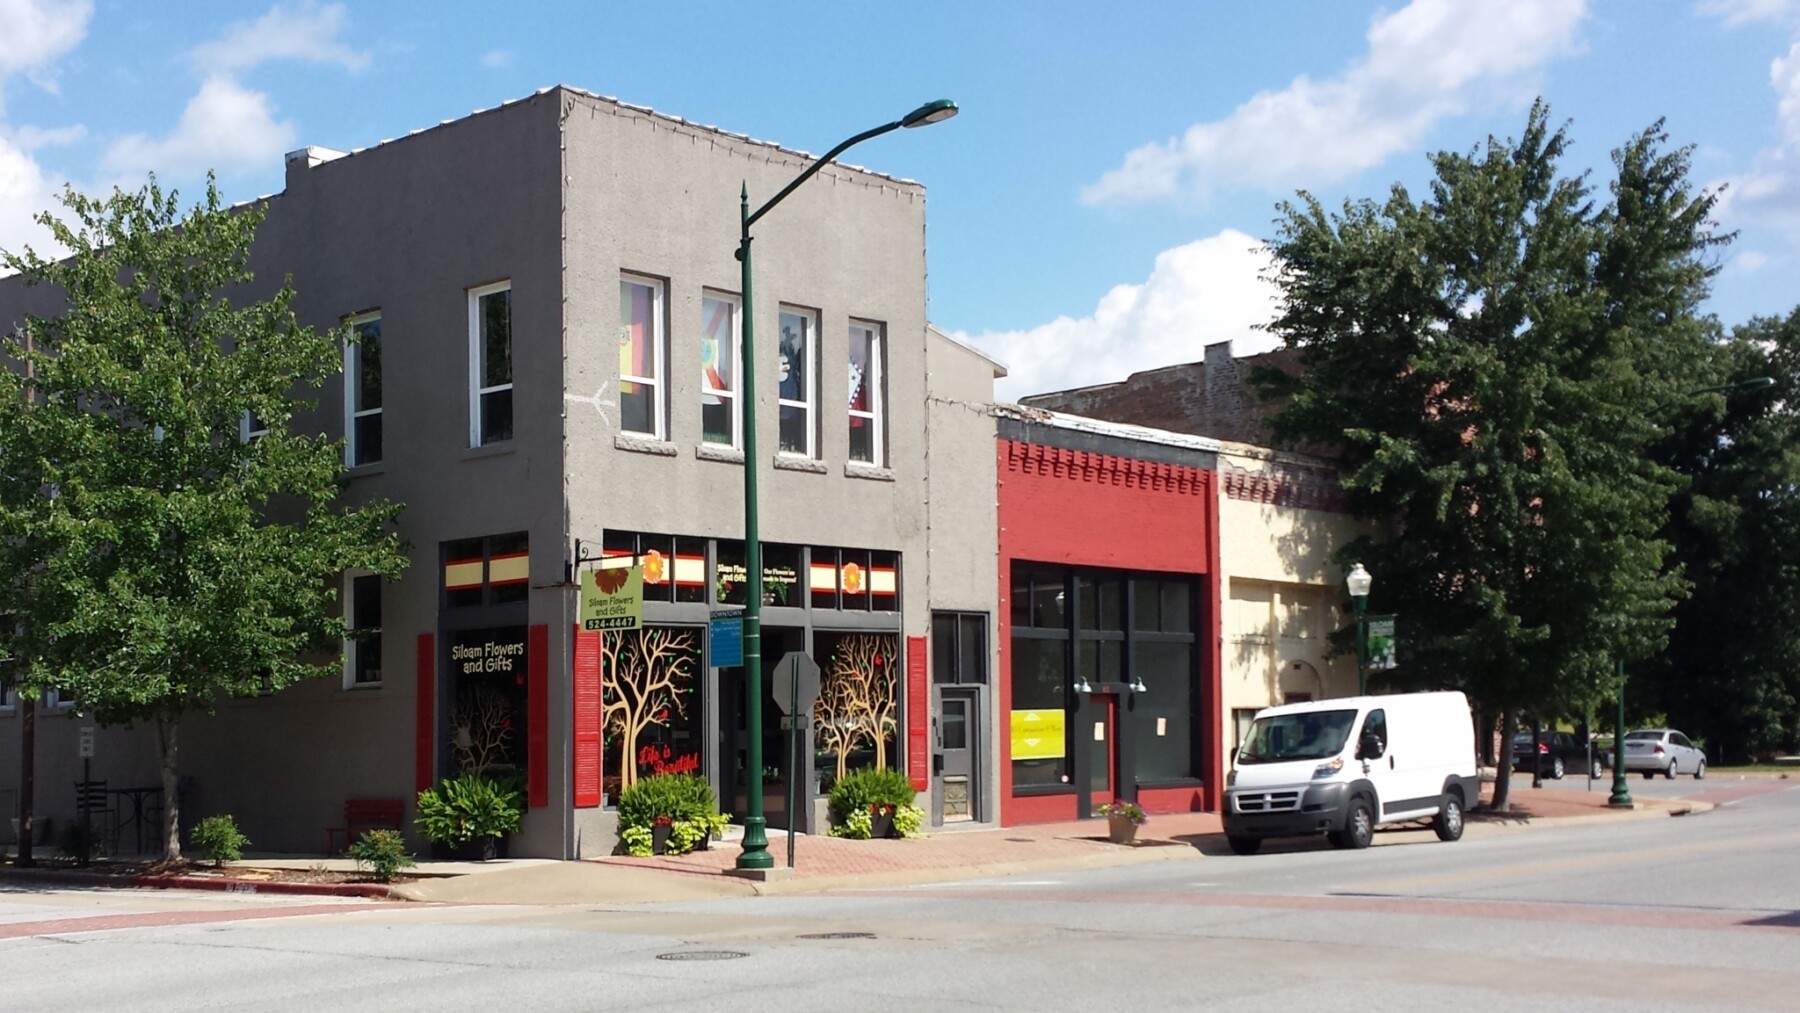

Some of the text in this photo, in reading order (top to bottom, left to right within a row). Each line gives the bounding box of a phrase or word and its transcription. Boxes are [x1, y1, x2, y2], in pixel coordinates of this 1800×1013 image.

[588, 596, 634, 608] Siloam Flowers
[595, 604, 627, 617] and Gifts
[710, 610, 742, 618] DOWNTOWN
[452, 641, 524, 660] Siloam Flowers
[463, 656, 513, 675] and Gifts
[663, 744, 672, 758] is
[654, 752, 698, 774] Beautiful
